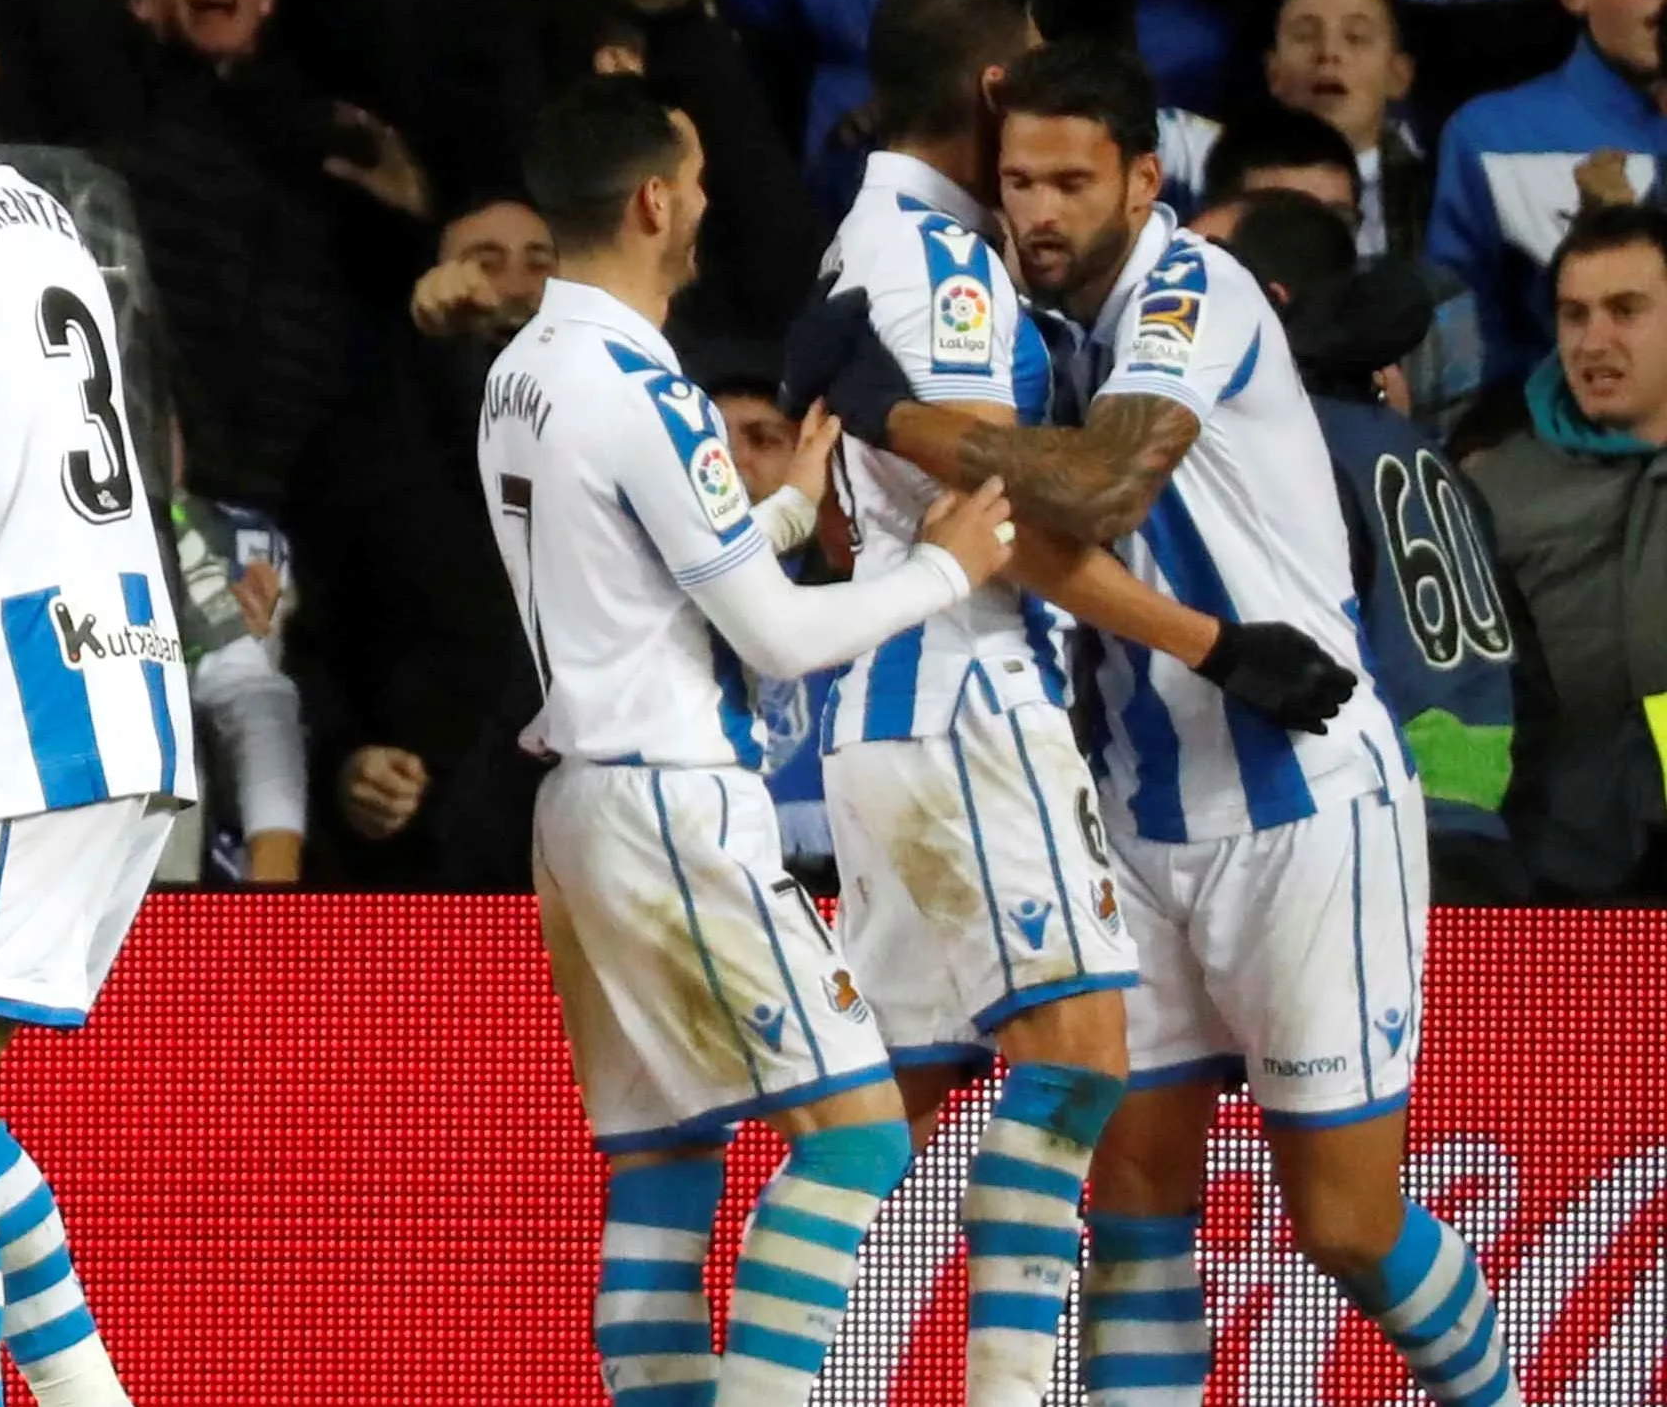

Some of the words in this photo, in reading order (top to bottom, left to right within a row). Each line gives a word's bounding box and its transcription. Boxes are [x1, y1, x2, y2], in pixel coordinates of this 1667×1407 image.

[939, 336, 986, 351] LaLiga
[35, 286, 133, 525] 3
[1374, 451, 1515, 671] 60
[55, 602, 183, 664] Kutxaban
[1076, 787, 1110, 870] 6
[770, 876, 837, 956] 7
[1262, 1056, 1347, 1076] macron
